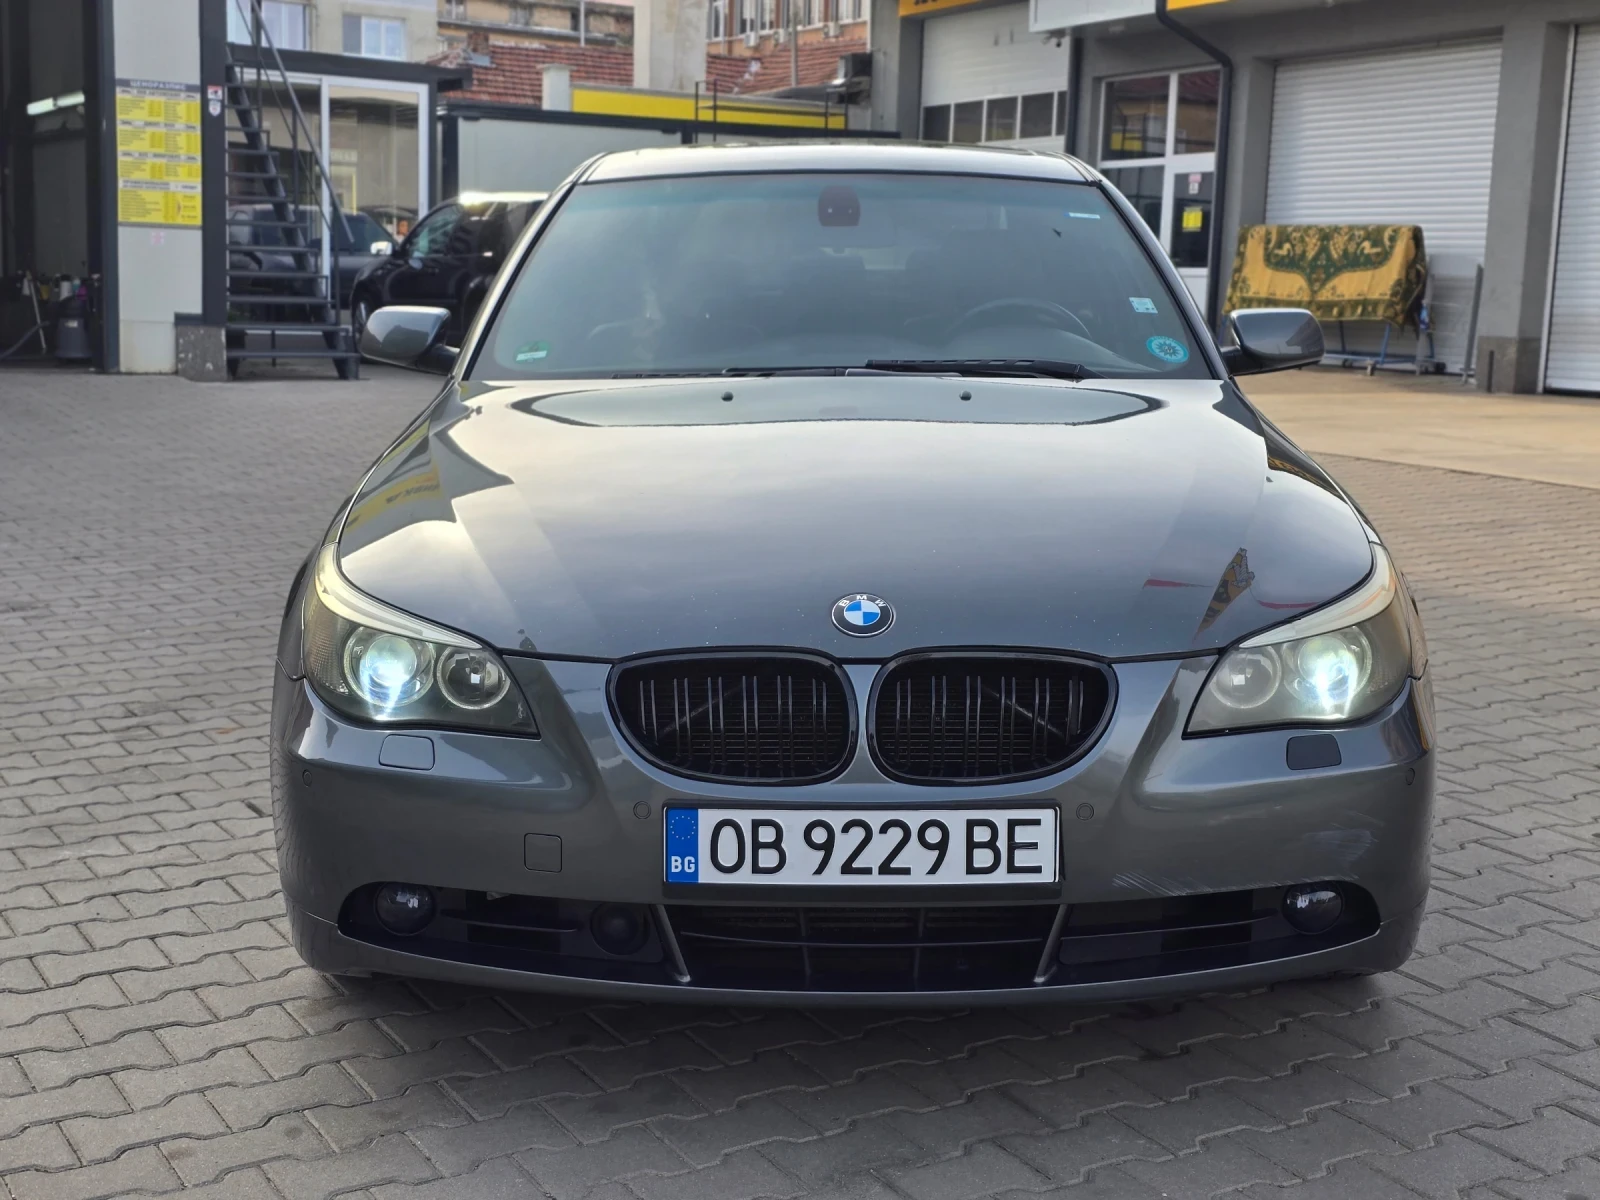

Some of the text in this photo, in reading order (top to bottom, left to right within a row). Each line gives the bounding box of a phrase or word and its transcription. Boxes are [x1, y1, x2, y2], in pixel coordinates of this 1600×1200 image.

[838, 594, 887, 607] BMW
[710, 818, 1043, 875] OB 9229 BE
[671, 856, 696, 873] BG
